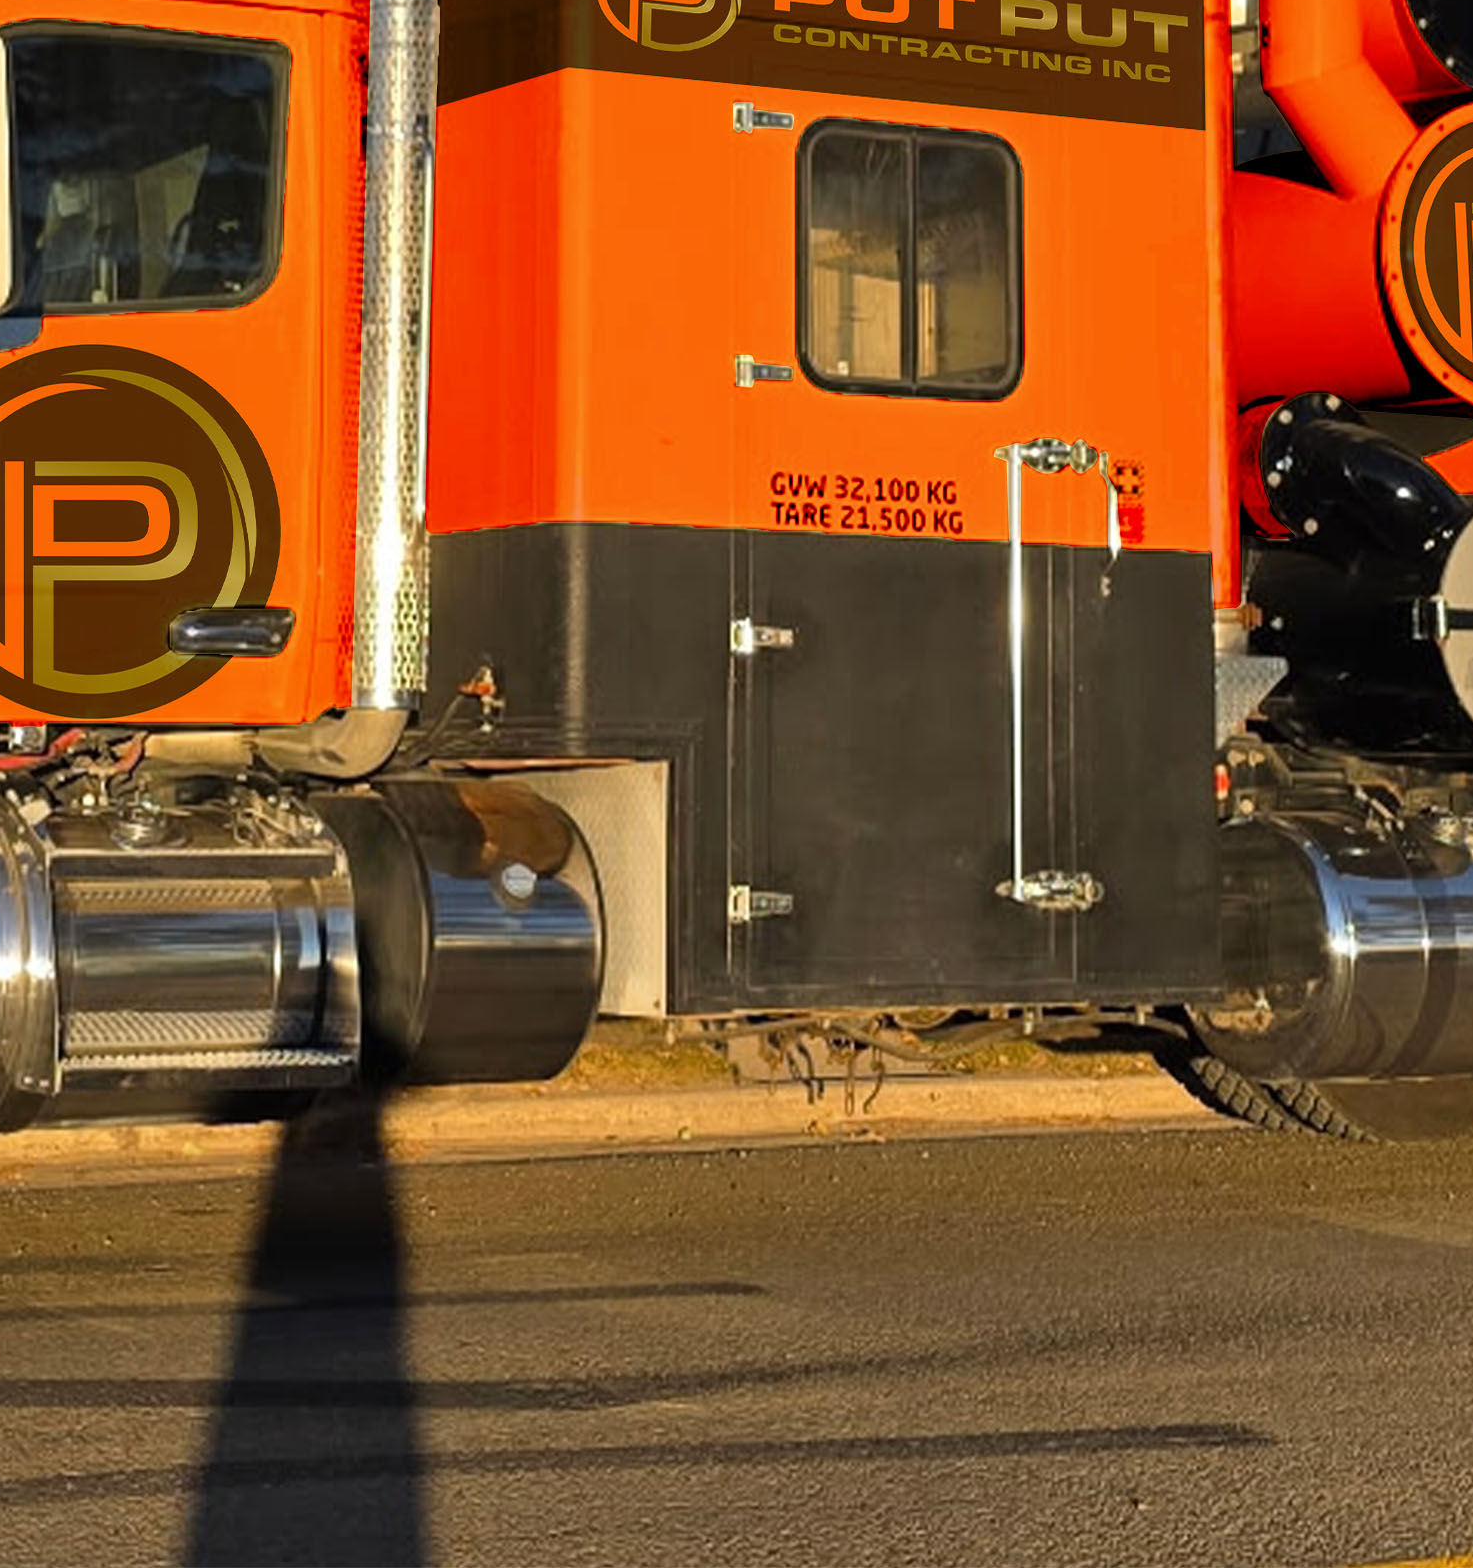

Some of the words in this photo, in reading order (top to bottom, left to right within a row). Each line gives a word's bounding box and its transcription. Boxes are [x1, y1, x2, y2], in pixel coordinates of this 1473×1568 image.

[773, 24, 1093, 75] CONTRACTING
[1101, 59, 1171, 84] INC
[771, 471, 827, 498] GVW
[835, 475, 920, 504] 32,100
[927, 480, 957, 505] KG
[770, 501, 831, 529] TARE
[933, 509, 964, 535] KG
